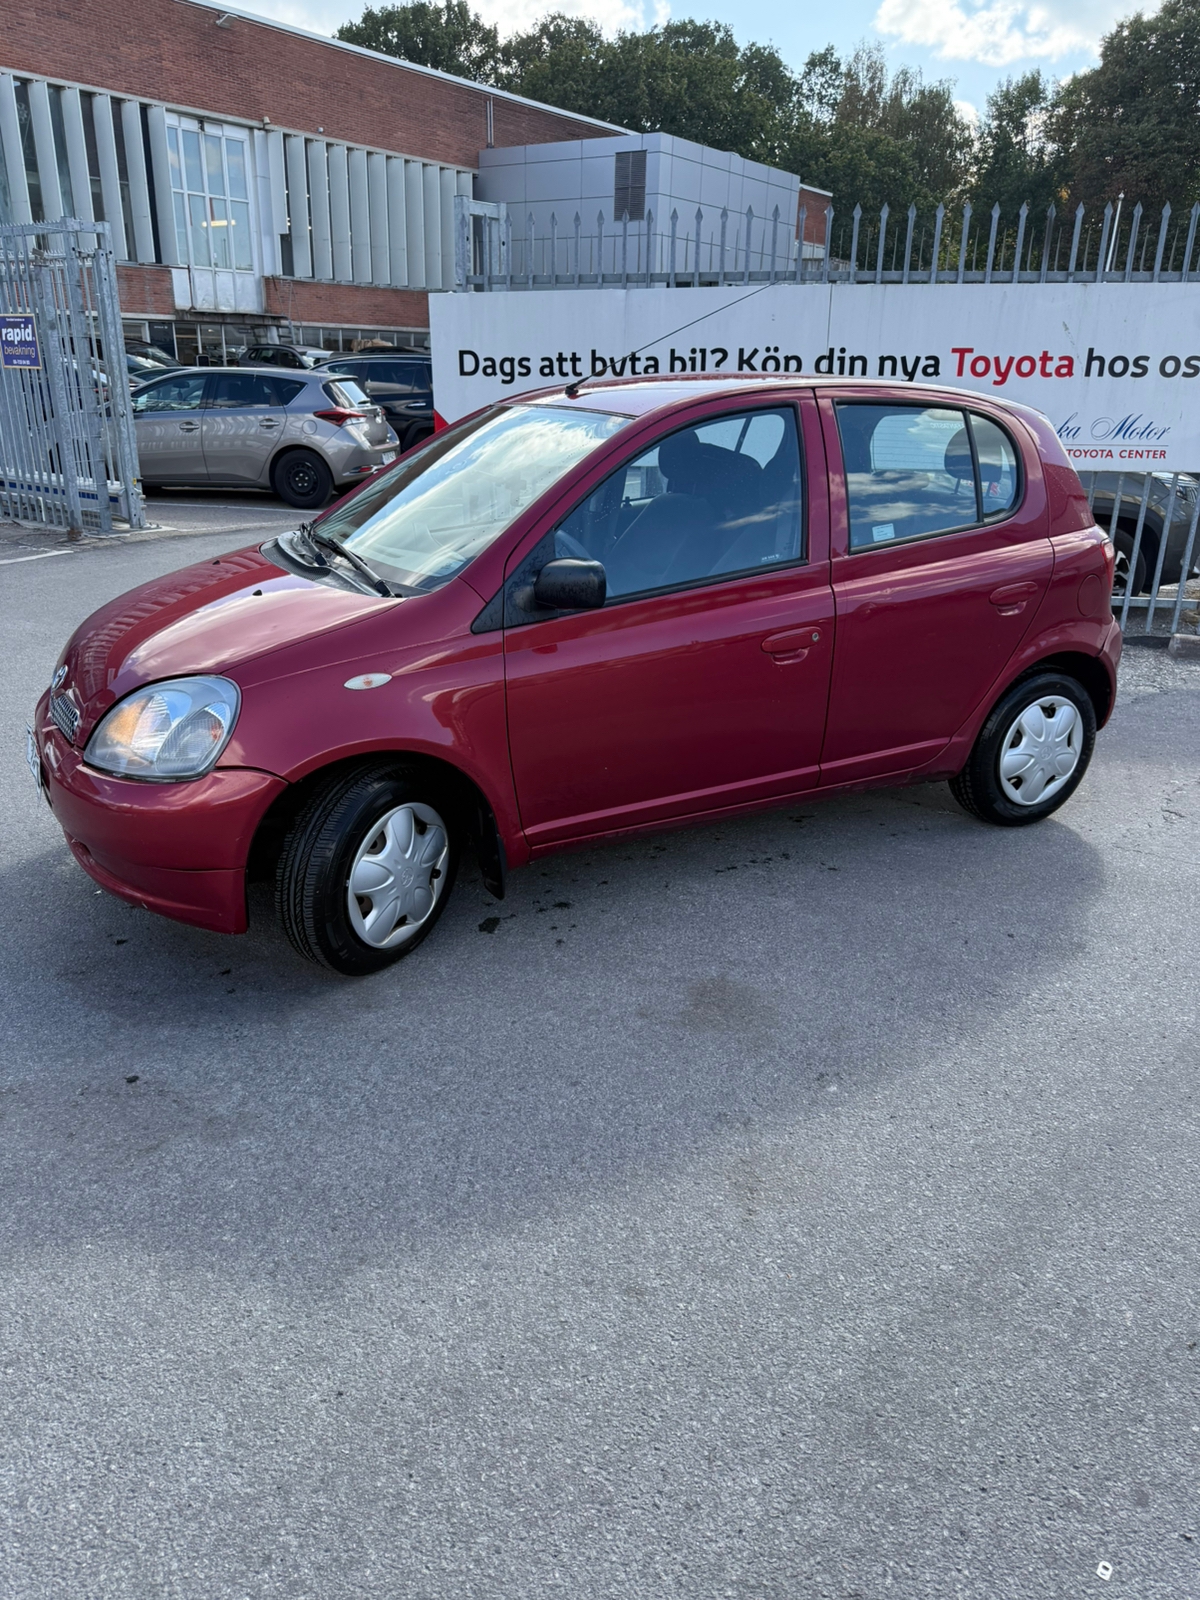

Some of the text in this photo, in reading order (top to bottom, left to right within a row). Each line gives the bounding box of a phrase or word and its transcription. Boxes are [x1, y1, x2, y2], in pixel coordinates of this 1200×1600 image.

[4, 344, 36, 359] bevakning
[458, 349, 532, 385] Dags
[539, 352, 583, 377] att
[669, 347, 729, 374] bil?
[814, 346, 868, 376] din
[878, 355, 941, 382] nya
[951, 347, 1075, 386] Toyota
[1084, 347, 1150, 378] hos
[1090, 412, 1171, 441] Motor
[1065, 449, 1167, 460] TOYOTA CENTER
